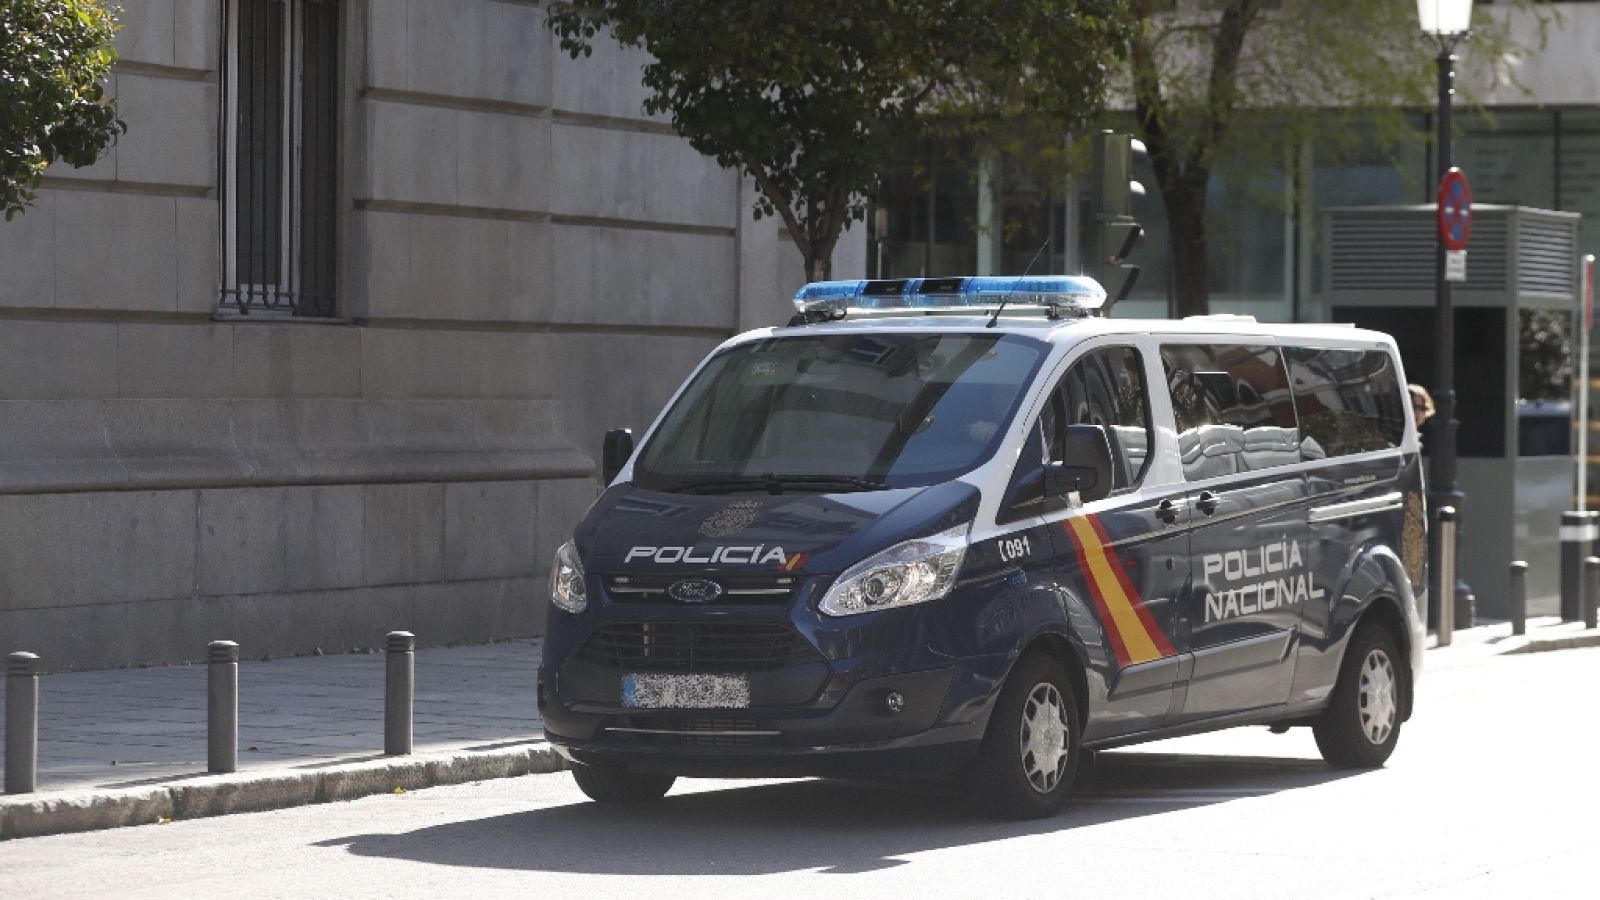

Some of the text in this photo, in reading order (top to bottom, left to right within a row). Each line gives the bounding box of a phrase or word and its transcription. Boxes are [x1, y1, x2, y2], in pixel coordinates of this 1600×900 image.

[624, 544, 787, 563] POLICÍA
[1203, 534, 1302, 584] POLICÍA
[1205, 573, 1324, 622] NACIONAL
